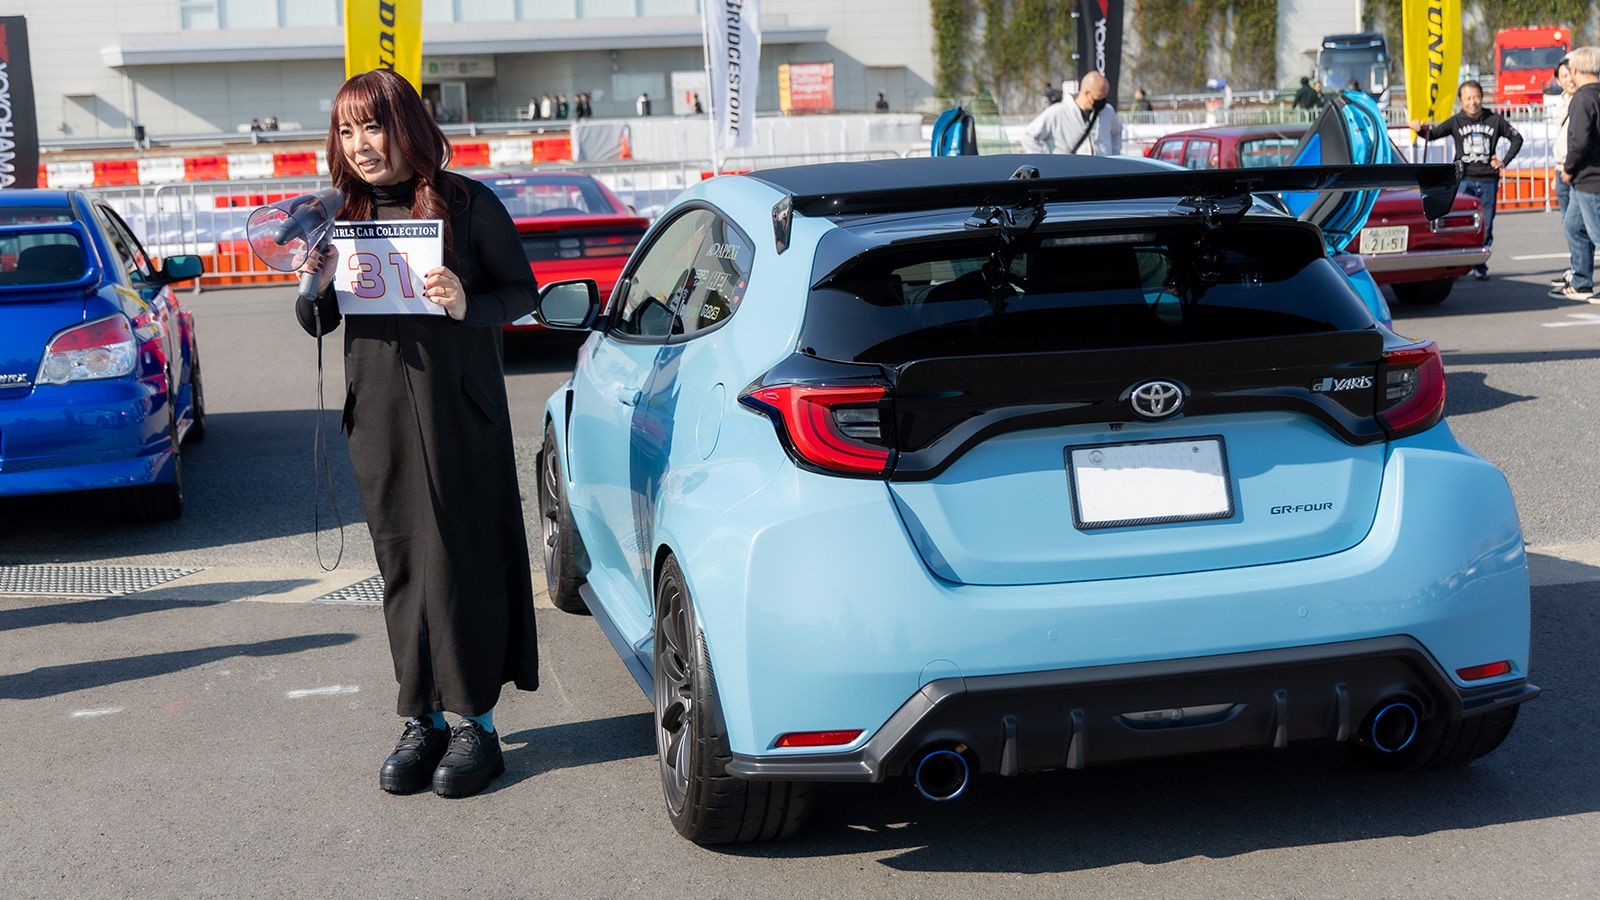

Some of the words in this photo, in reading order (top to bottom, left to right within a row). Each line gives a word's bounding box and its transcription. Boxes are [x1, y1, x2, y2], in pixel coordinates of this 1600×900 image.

[1094, 17, 1107, 77] YOKO
[1427, 0, 1444, 118] UNLO
[356, 226, 375, 237] CAR
[376, 226, 437, 236] COLLECTION
[348, 252, 415, 299] 31
